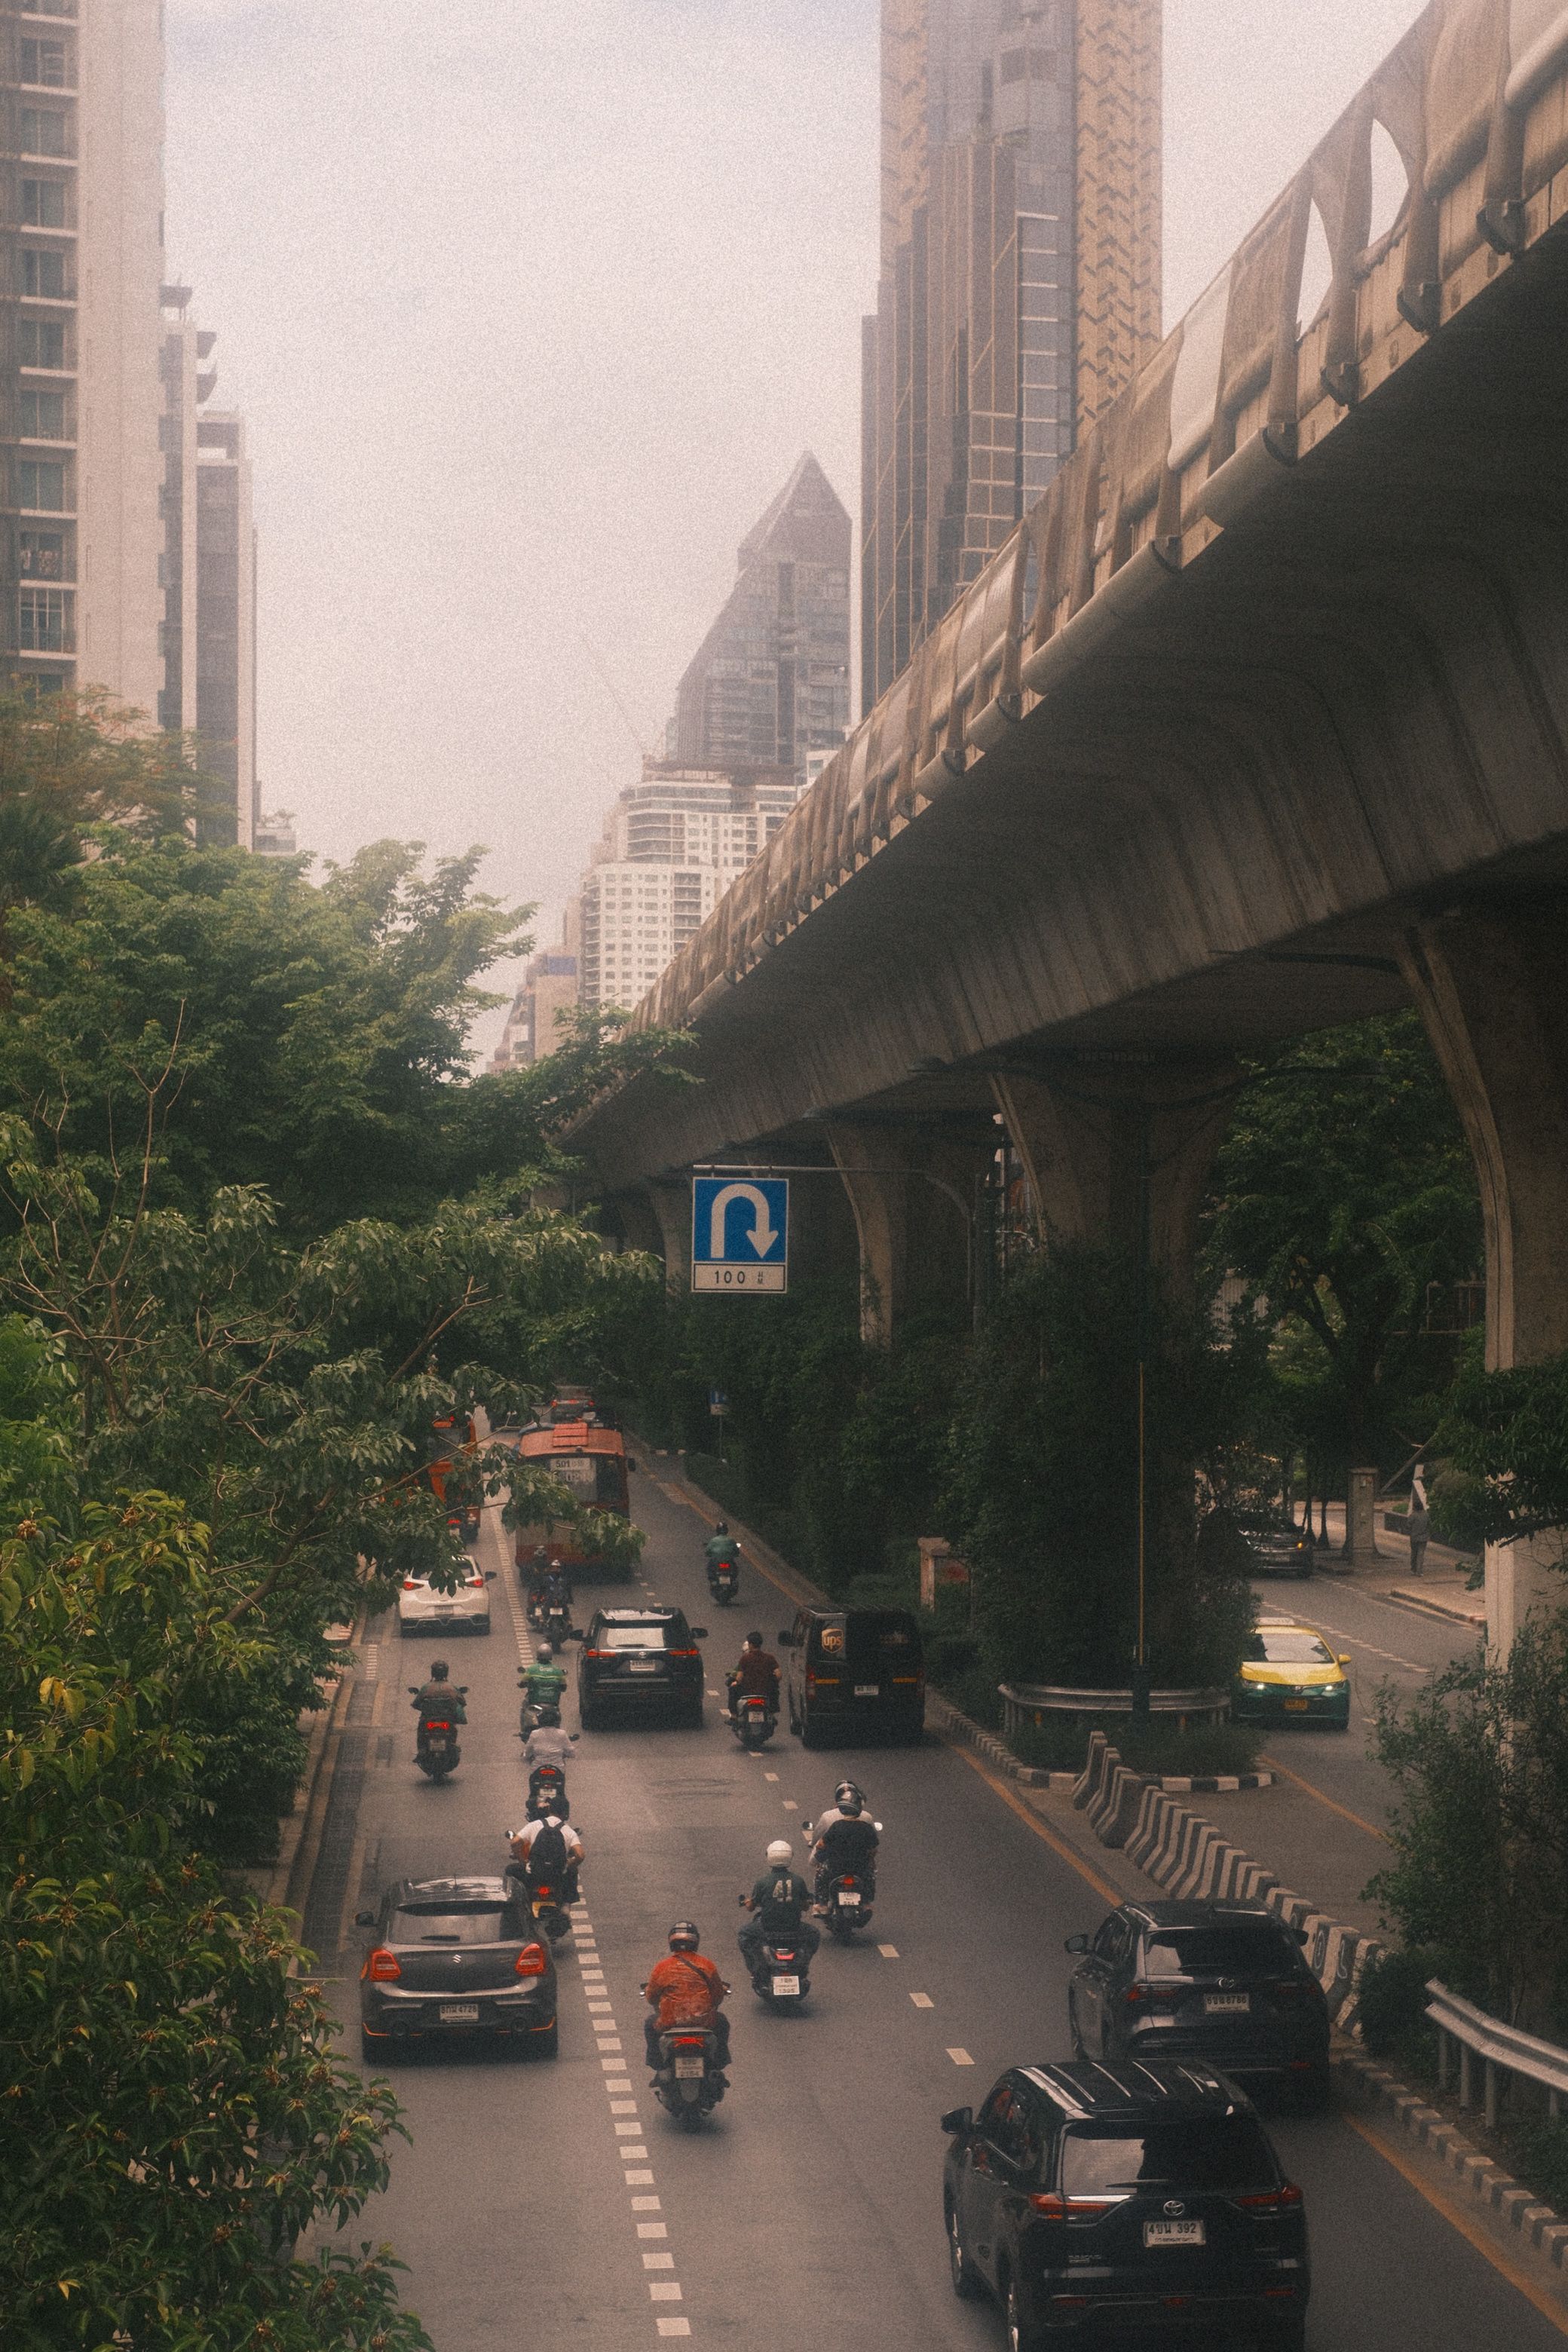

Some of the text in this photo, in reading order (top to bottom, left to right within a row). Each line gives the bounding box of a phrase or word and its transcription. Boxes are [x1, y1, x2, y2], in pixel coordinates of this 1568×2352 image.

[715, 1270, 746, 1285] 100
[556, 1459, 570, 1468] 501
[823, 1636, 842, 1650] ups
[772, 1879, 792, 1902] 41
[1177, 2222, 1197, 2234] 392
